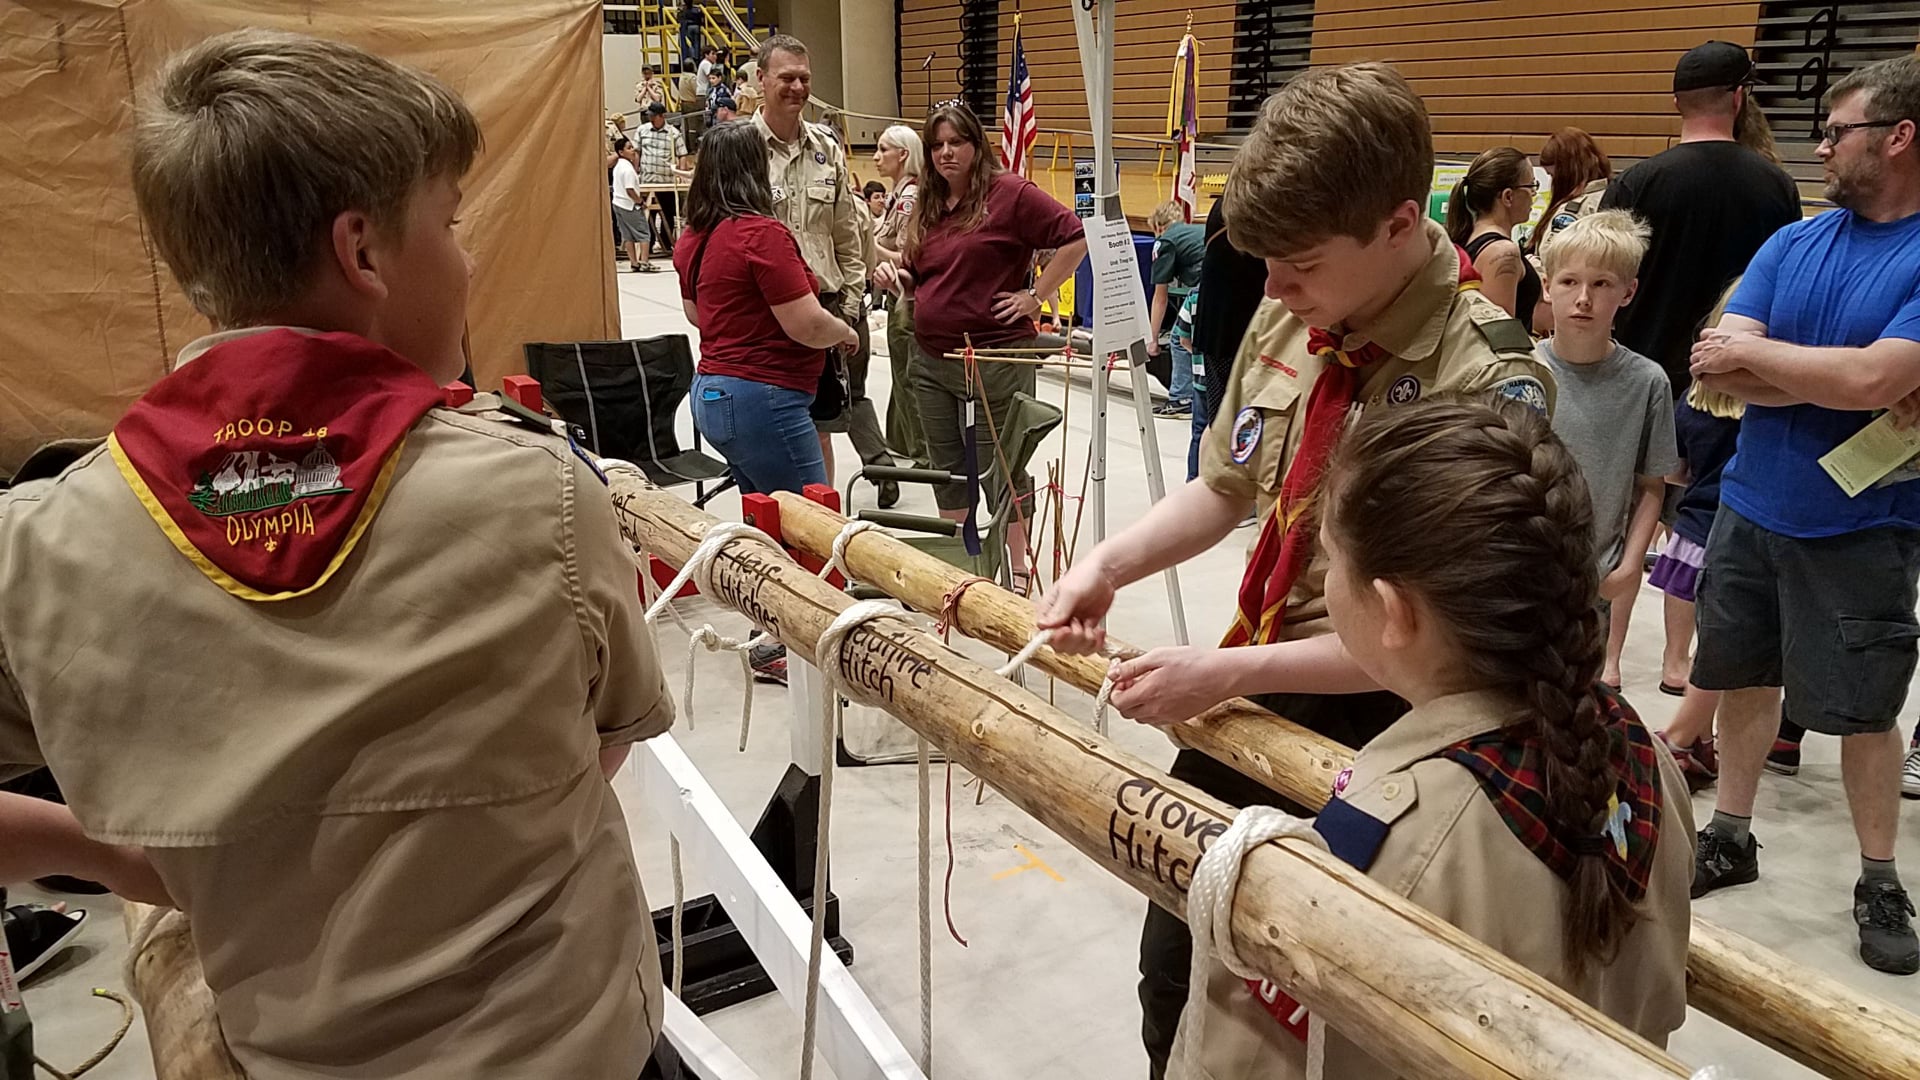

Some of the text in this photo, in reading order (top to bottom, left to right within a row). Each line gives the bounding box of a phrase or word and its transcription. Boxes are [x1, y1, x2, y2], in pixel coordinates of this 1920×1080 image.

[213, 418, 293, 444] TROOP
[226, 503, 315, 546] OLYMPIA
[719, 567, 781, 638] Hitches
[840, 640, 894, 703] Hitch
[1116, 778, 1229, 853] Clove
[1108, 809, 1202, 894] Hitc
